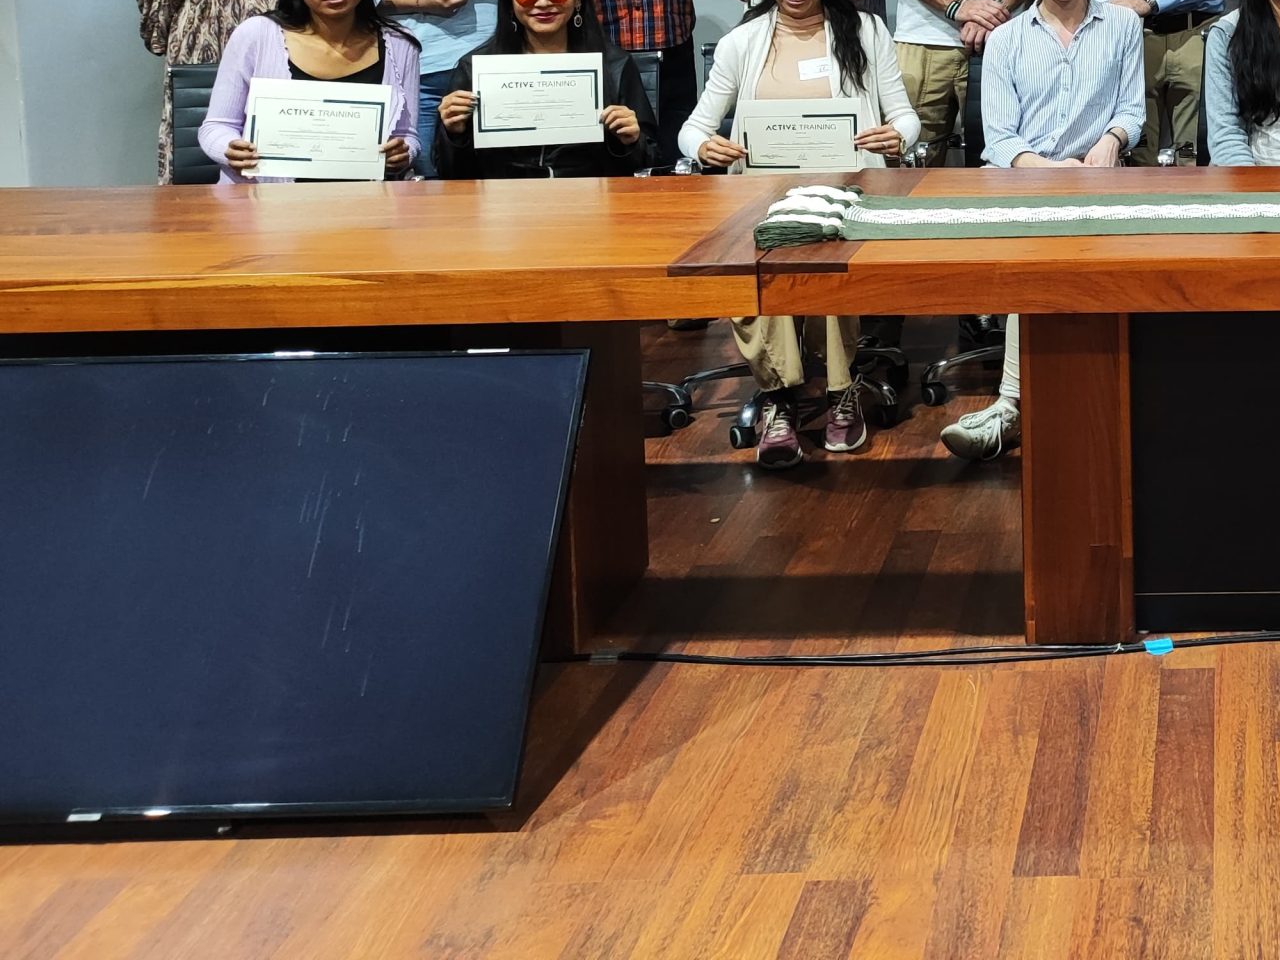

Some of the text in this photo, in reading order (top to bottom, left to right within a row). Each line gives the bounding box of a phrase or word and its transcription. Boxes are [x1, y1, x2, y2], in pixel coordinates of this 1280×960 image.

[500, 80, 577, 89] ACTIVE TRAINING
[279, 108, 361, 119] ACTIVE TRAINING
